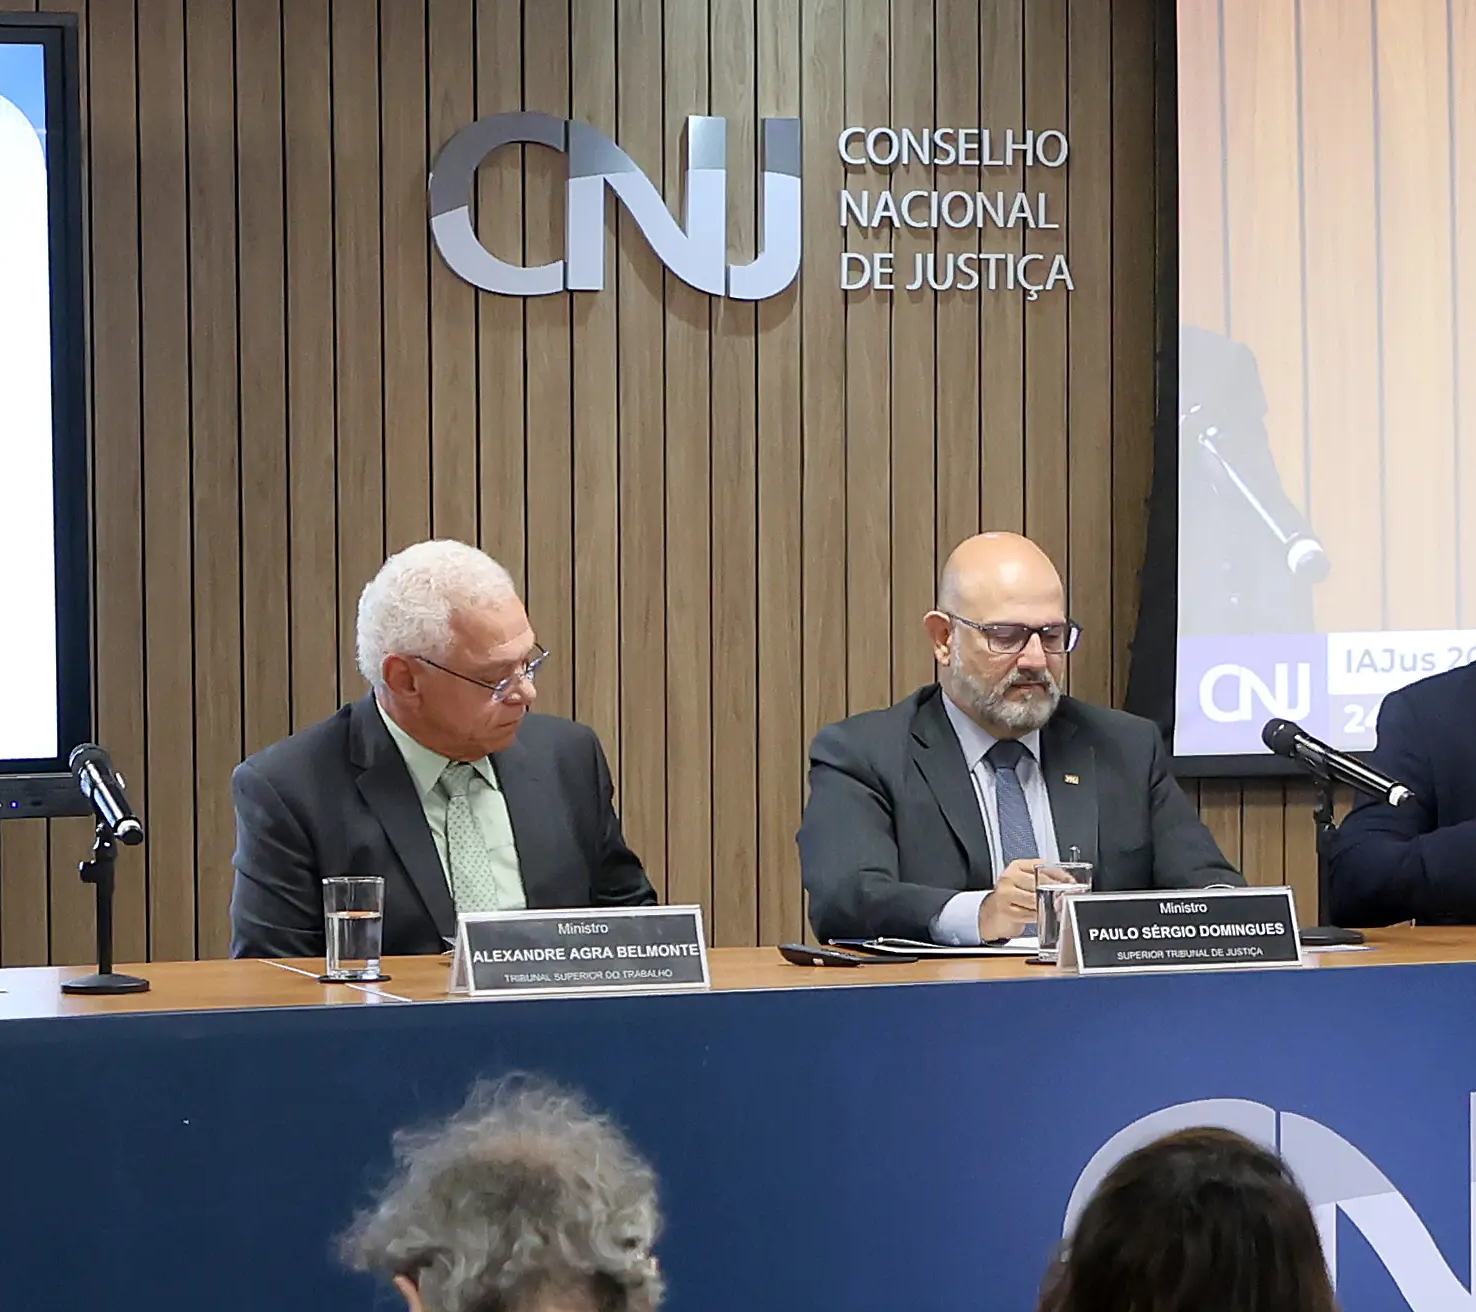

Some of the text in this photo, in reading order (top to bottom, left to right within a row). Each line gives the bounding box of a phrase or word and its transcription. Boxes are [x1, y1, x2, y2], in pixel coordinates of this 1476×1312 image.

[837, 126, 1069, 168] CONSELHO
[428, 110, 802, 300] CNJ
[839, 190, 1060, 230] NACIONAL
[840, 251, 1075, 302] DE JUSTIÇA
[1345, 647, 1436, 674] IAJus
[1199, 661, 1311, 722] CNJ
[1159, 902, 1208, 915] Ministro
[557, 922, 609, 936] Ministro
[1088, 922, 1285, 941] PAULO SÉRGIO DOMINGUES
[473, 943, 700, 963] ALEXANDRE AGRA BELMONTE
[1116, 946, 1264, 961] SUPERIOR TRIBUNAL DE JUSTIÇA
[553, 970, 603, 982] SUPERIOR
[605, 970, 621, 980] DO
[622, 968, 673, 980] TRABALHO
